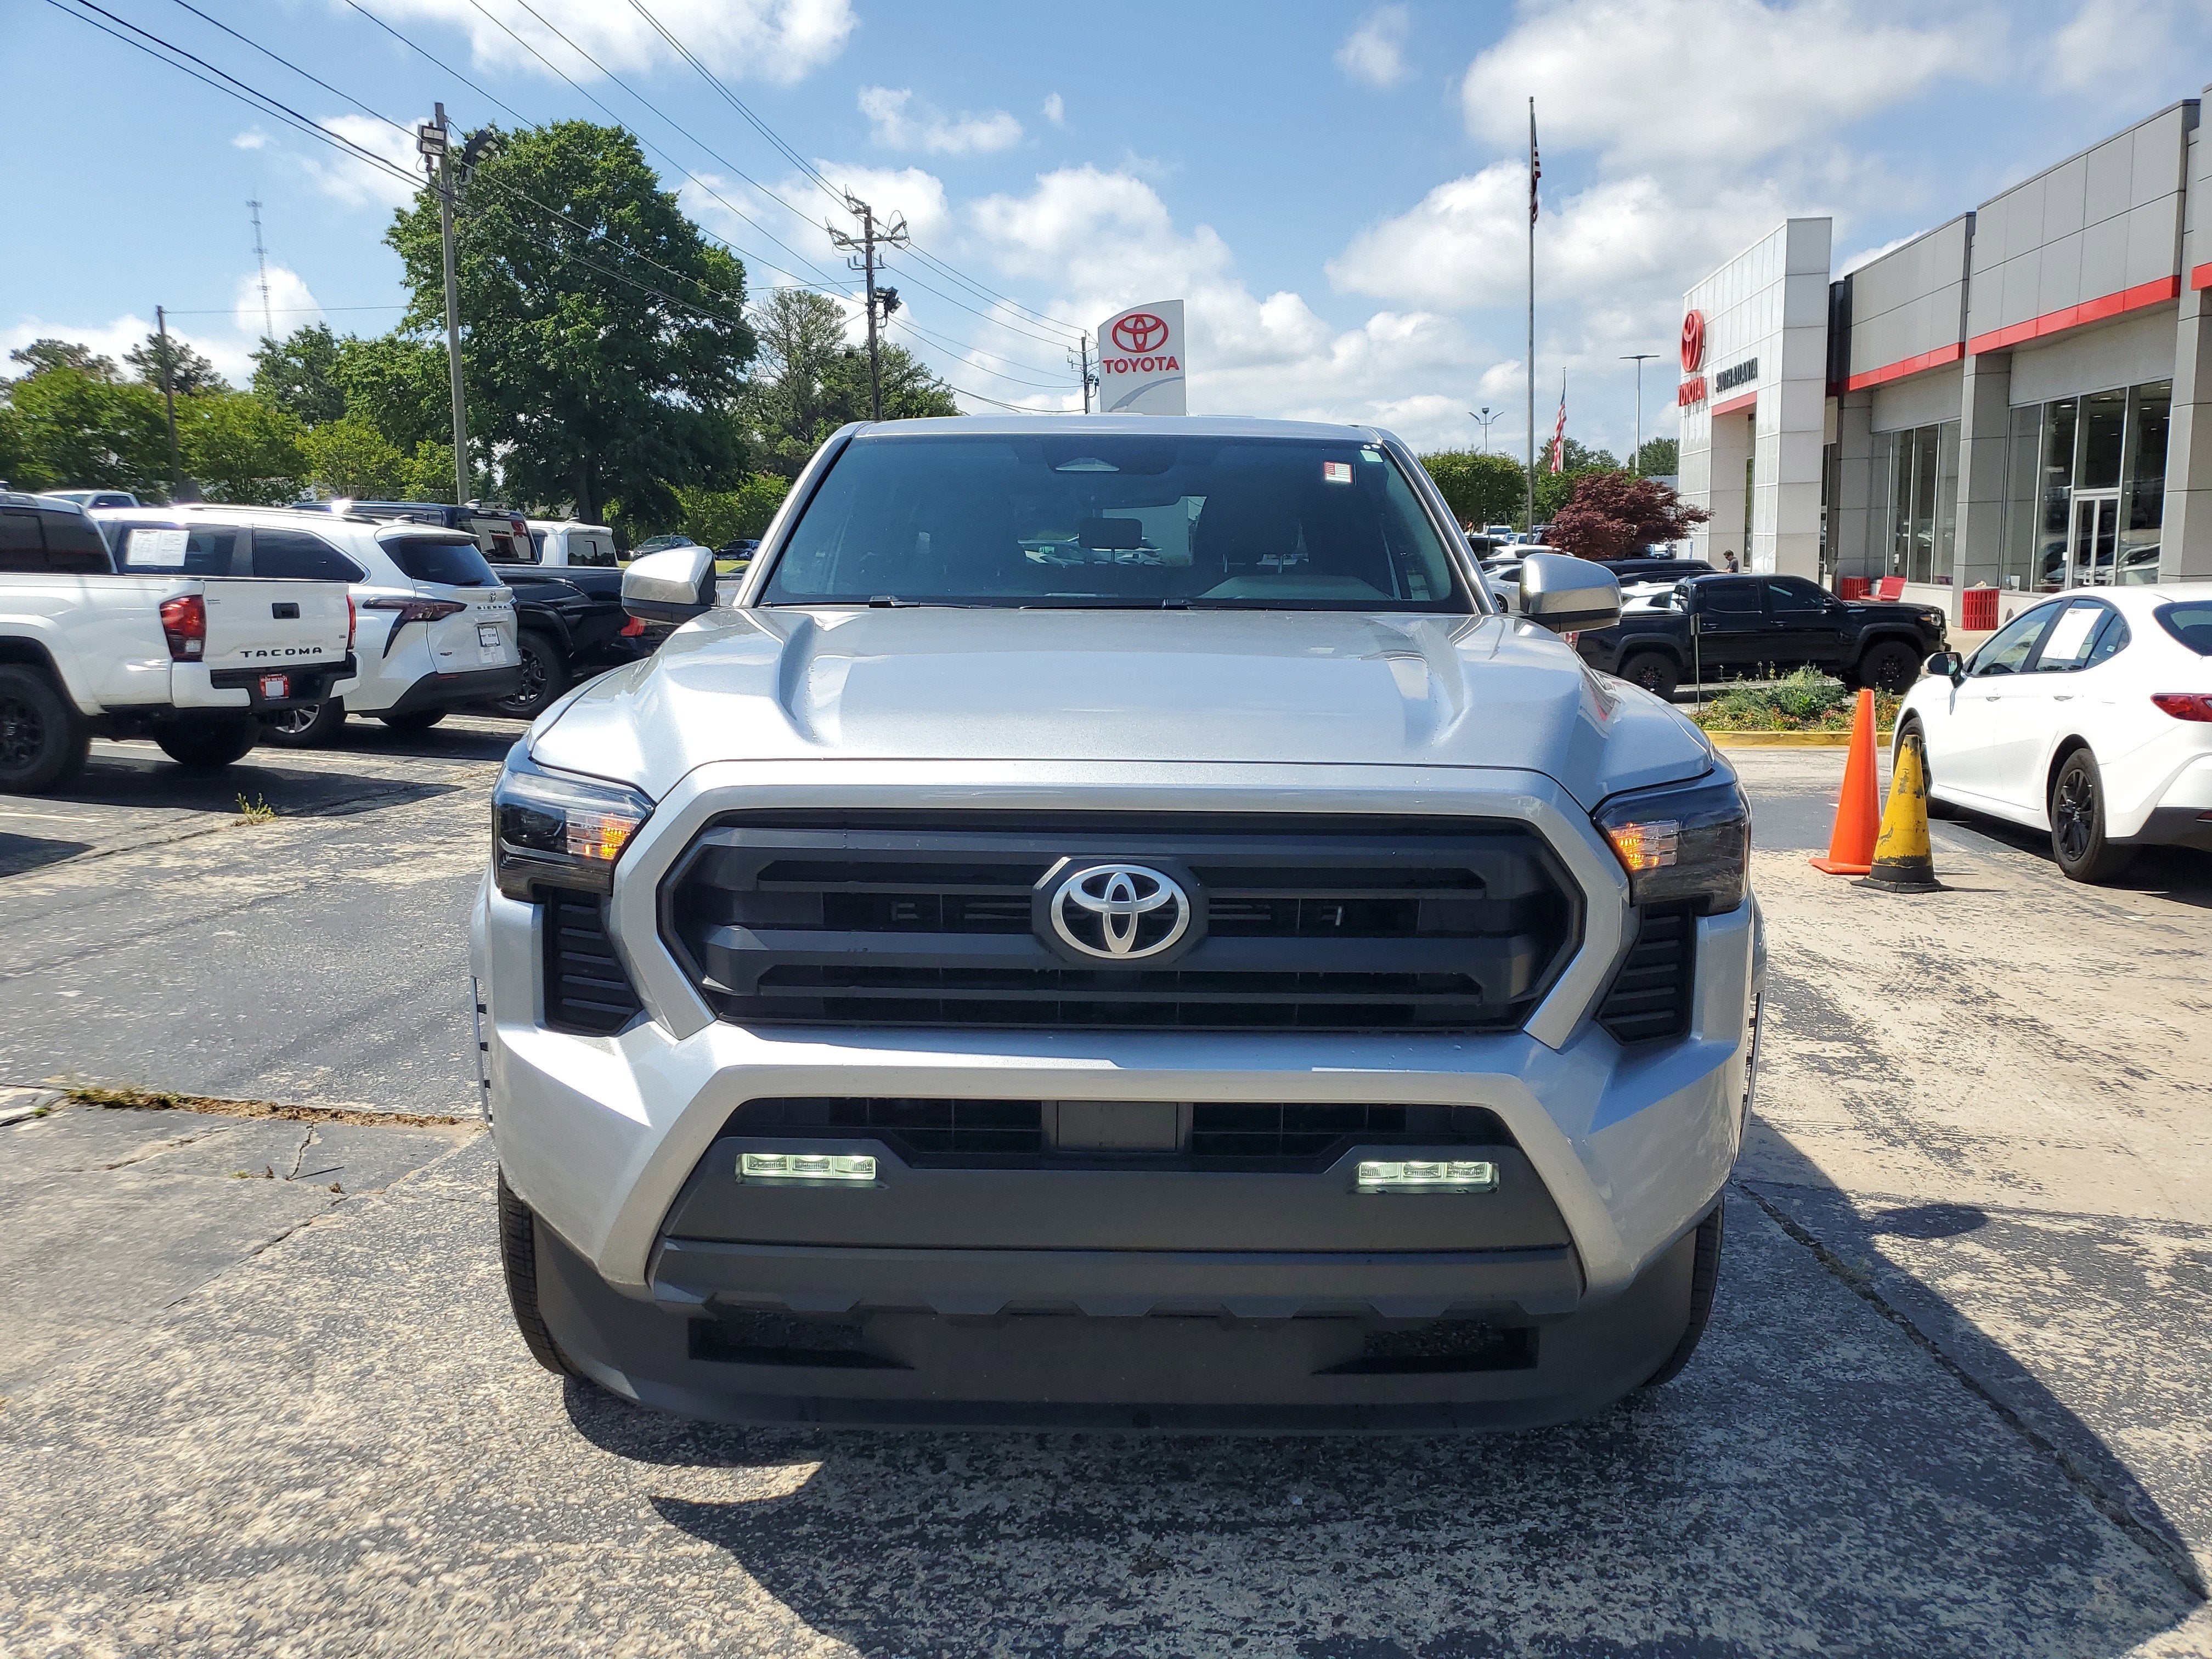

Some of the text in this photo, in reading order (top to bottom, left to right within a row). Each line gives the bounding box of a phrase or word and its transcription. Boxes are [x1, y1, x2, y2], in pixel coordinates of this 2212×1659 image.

[1103, 356, 1180, 374] TOYOTA
[1733, 357, 1758, 386] ATLANTA
[1678, 376, 1706, 407] TOYOTA
[240, 647, 323, 658] TACOMA
